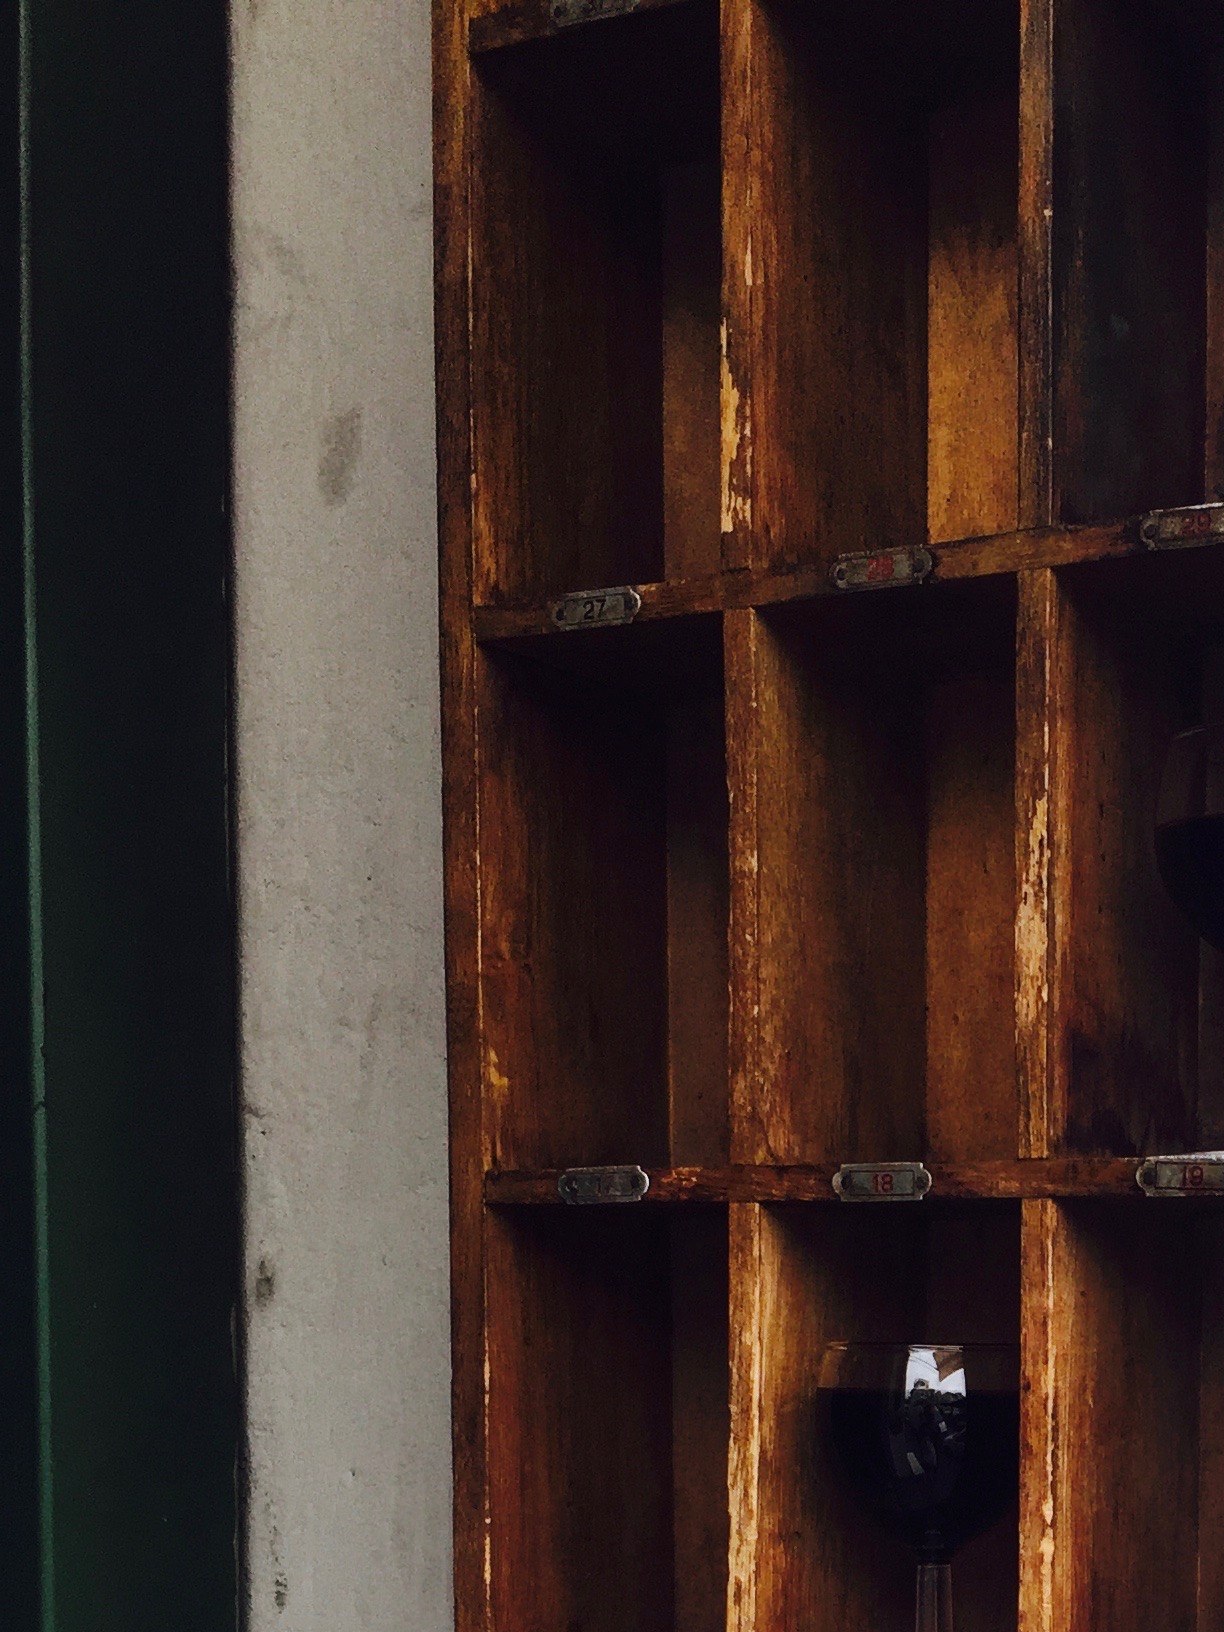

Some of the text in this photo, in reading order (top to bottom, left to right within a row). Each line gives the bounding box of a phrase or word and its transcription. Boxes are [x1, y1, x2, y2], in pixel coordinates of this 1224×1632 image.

[583, 599, 606, 621] 27
[872, 1173, 894, 1193] 18
[1182, 1166, 1204, 1187] 19
